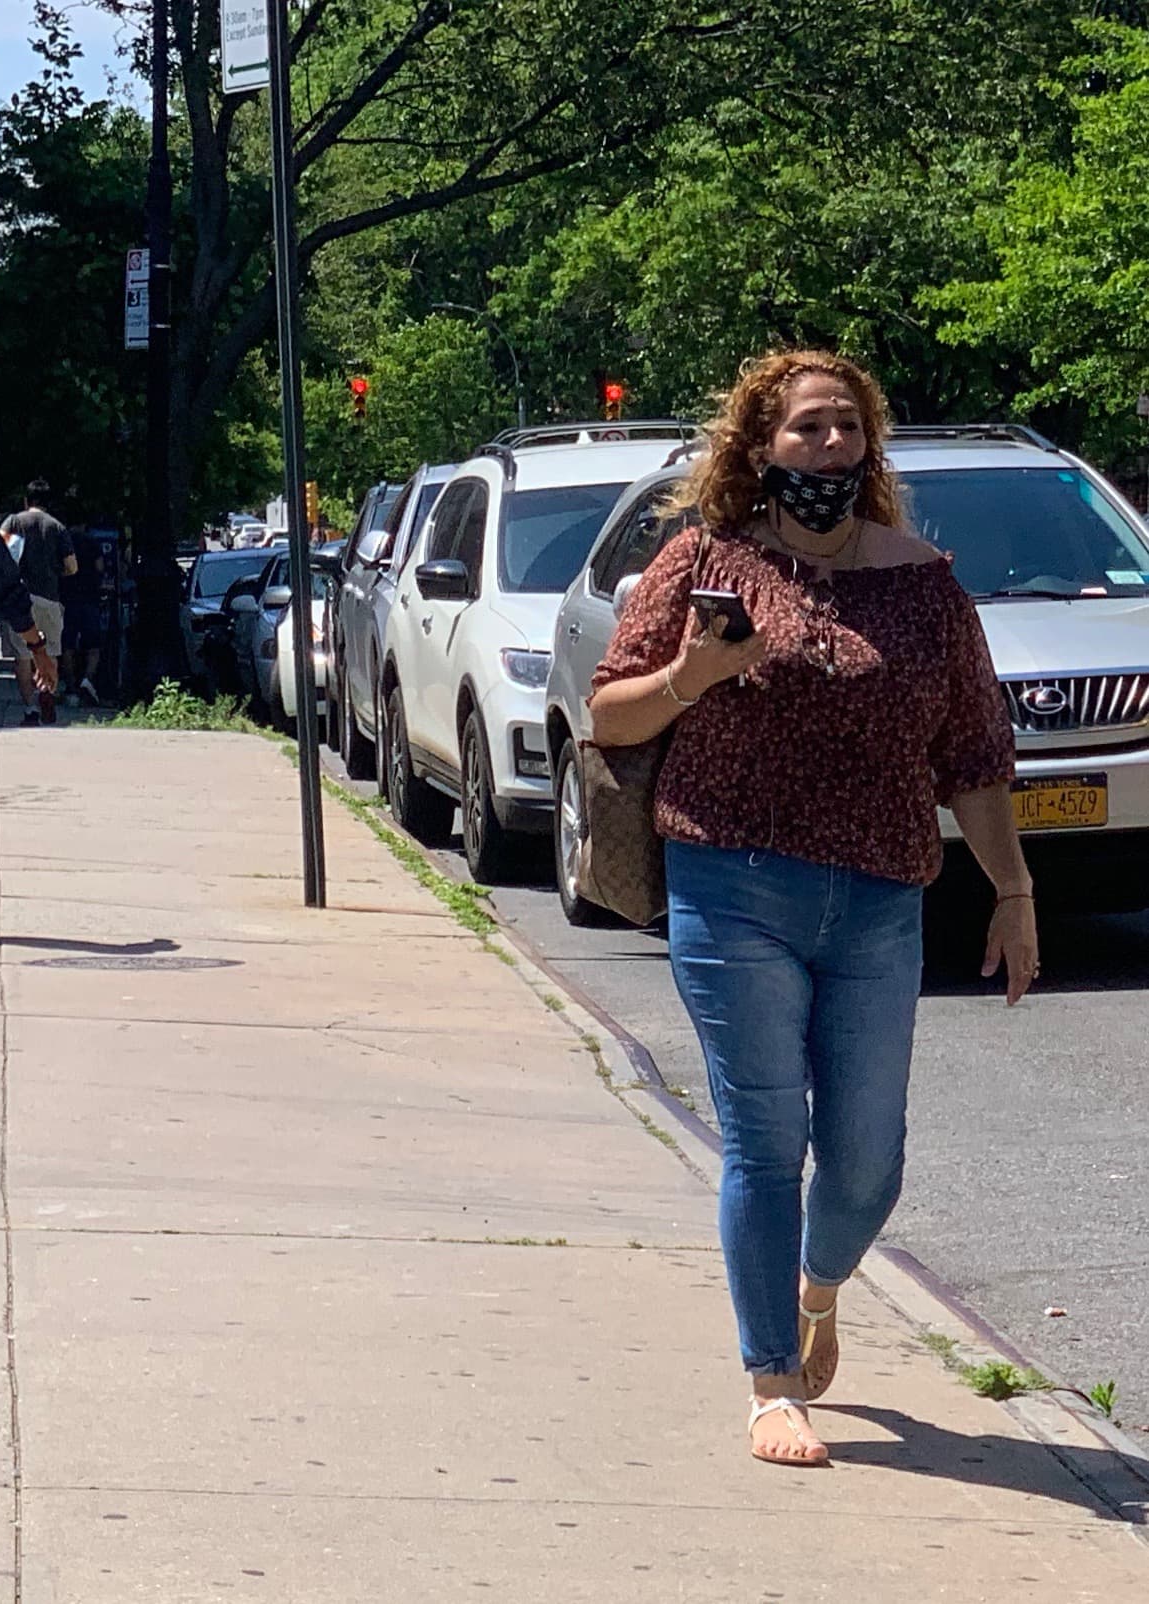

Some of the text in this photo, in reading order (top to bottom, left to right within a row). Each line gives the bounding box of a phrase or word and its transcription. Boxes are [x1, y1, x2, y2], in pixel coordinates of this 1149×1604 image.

[247, 23, 267, 38] Sunda
[131, 292, 138, 305] 3
[1019, 790, 1098, 818] JCF 4529
